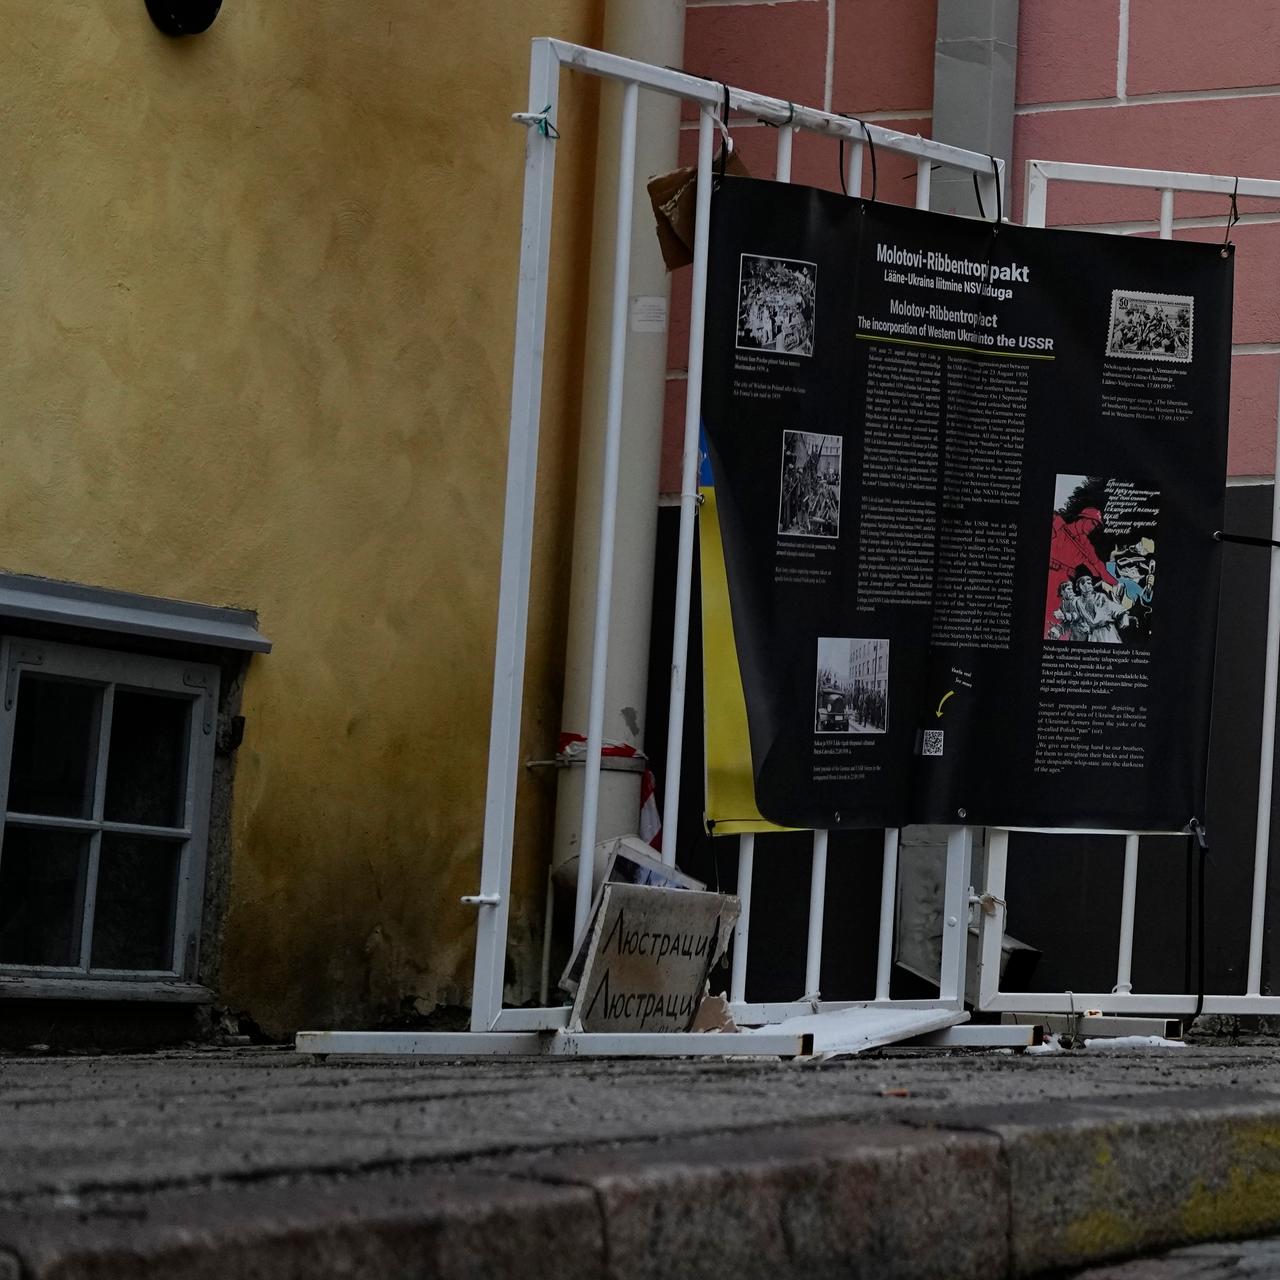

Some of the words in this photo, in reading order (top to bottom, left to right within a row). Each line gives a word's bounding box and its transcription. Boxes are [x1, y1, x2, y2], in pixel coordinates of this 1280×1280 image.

[884, 269, 934, 289] Lääne-Ukraina
[936, 276, 962, 292] liitmine
[964, 281, 981, 295] NSV
[990, 263, 1029, 283] pakt
[858, 315, 871, 329] The
[872, 318, 918, 336] incorporation
[919, 324, 926, 336] of
[928, 325, 956, 340] Western
[997, 334, 1016, 347] the
[1018, 336, 1054, 351] USSR
